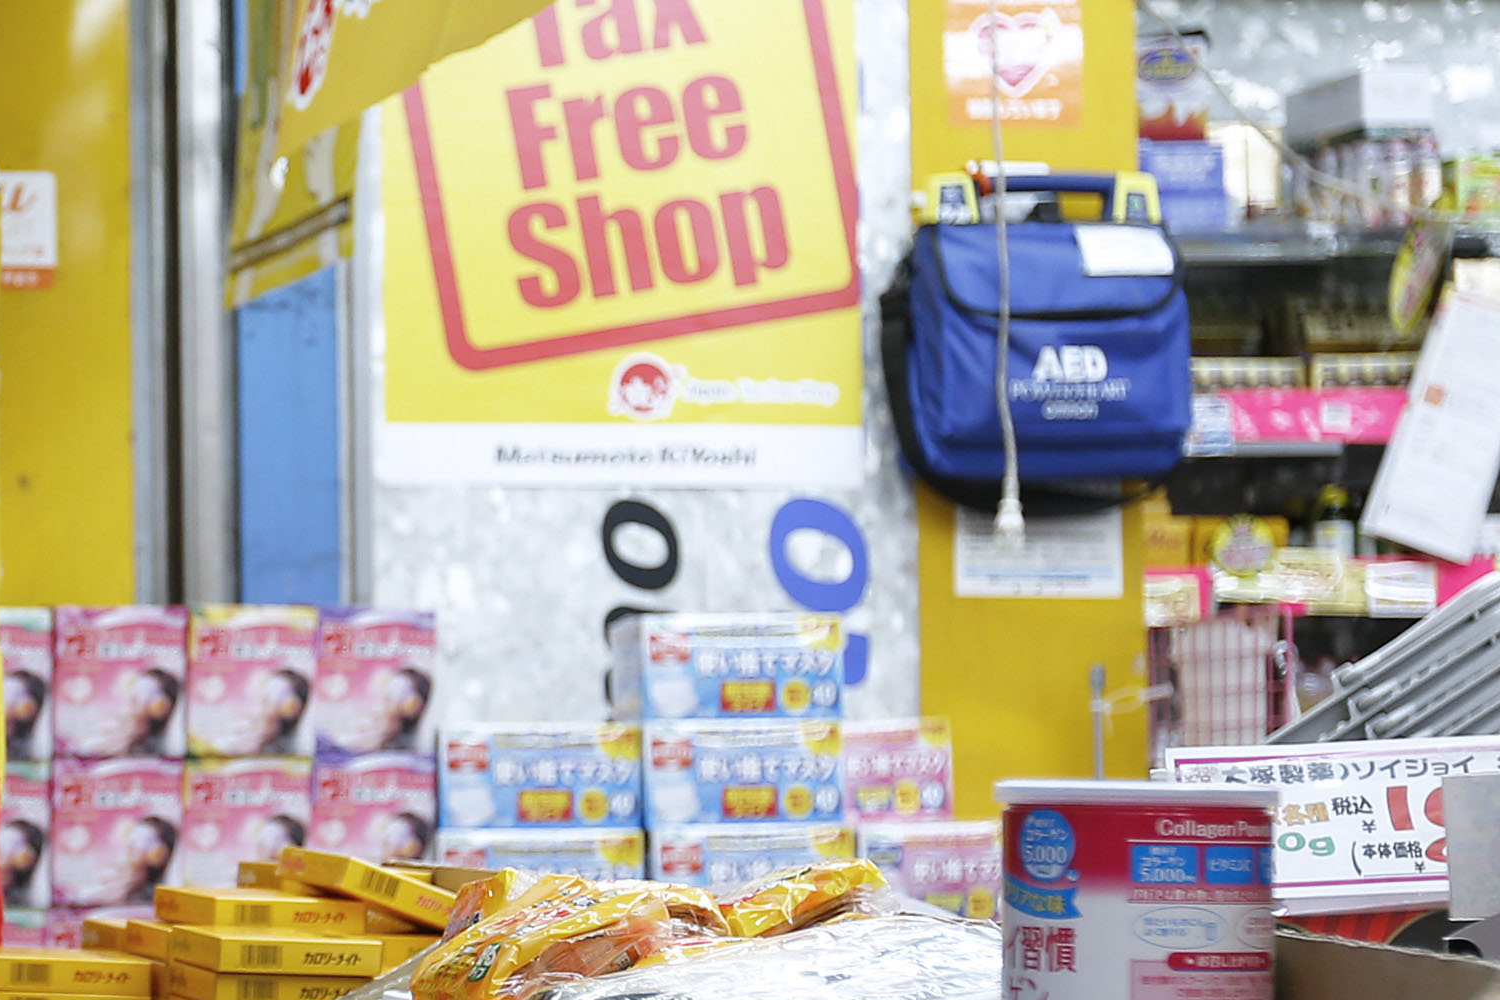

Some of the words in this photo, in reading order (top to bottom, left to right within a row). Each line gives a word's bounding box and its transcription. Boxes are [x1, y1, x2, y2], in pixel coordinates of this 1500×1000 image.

[505, 75, 748, 191] Free
[507, 186, 790, 308] Shop
[1032, 344, 1108, 383] AED
[1331, 796, 1374, 817] 税込
[1158, 818, 1236, 839] Collagen
[302, 951, 362, 967] カロリーメイト
